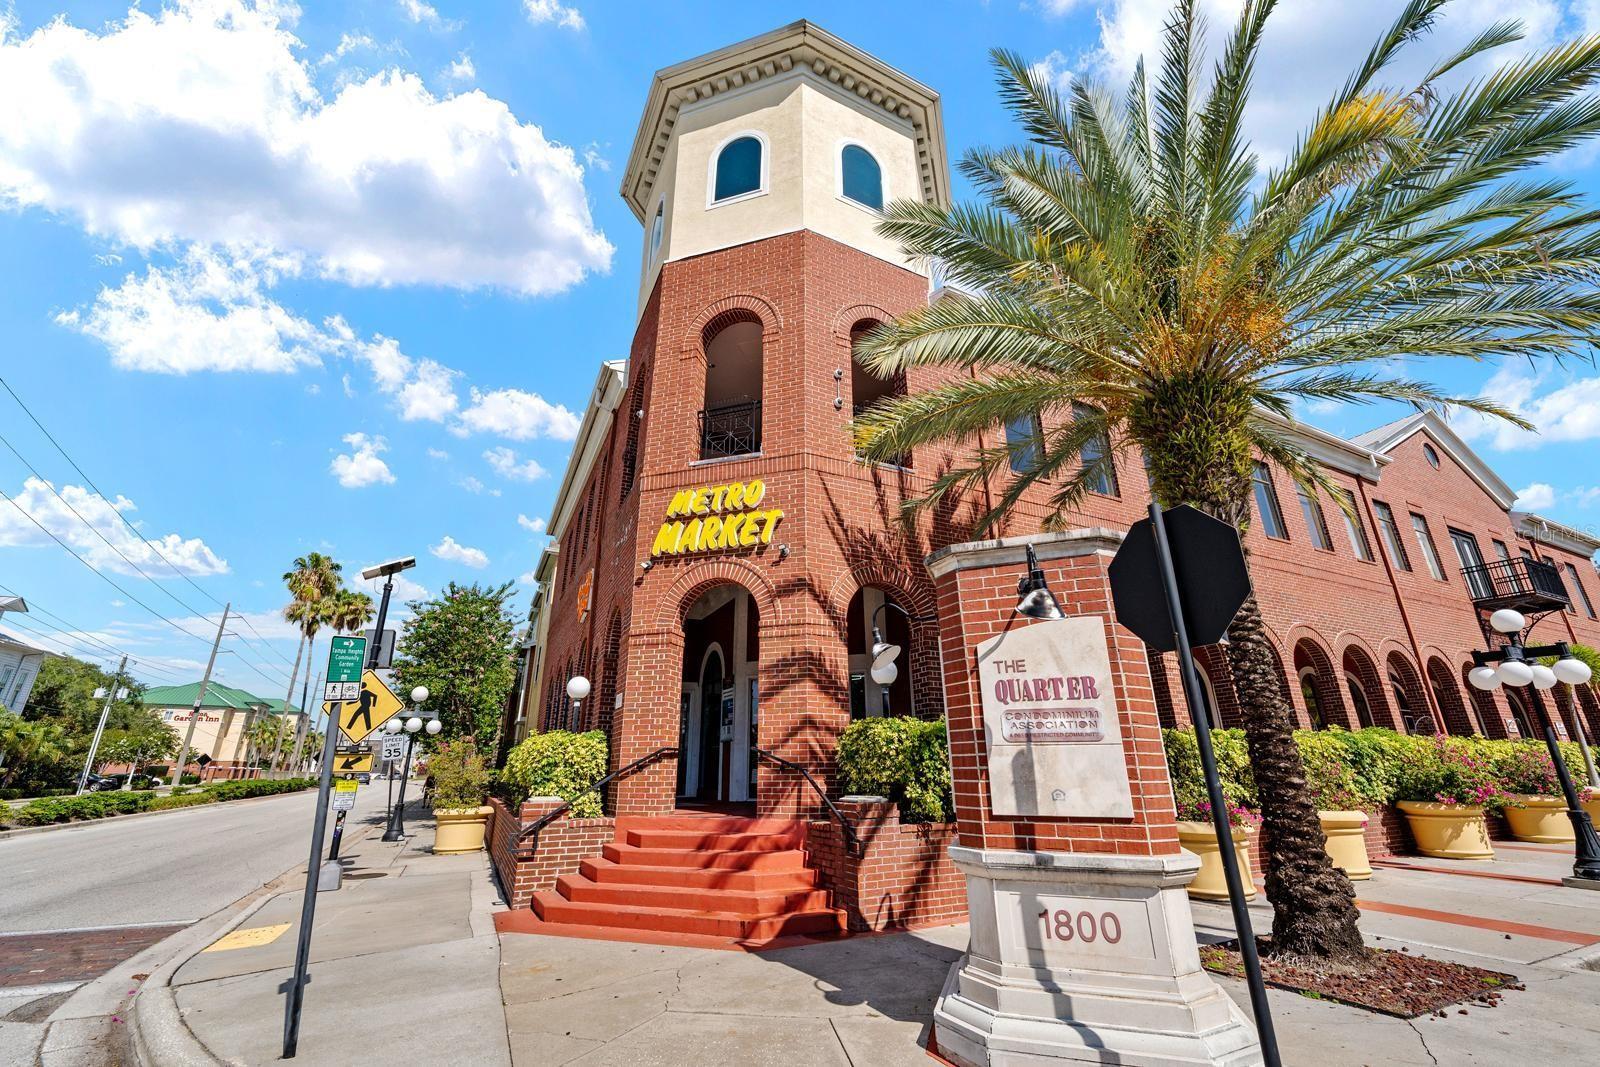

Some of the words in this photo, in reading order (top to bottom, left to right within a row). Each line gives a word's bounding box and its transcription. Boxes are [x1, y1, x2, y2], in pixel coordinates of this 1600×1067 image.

[667, 480, 765, 519] METRO
[652, 509, 785, 557] MARKET
[335, 654, 359, 662] Community
[993, 659, 1026, 673] THE
[995, 676, 1100, 705] QUARTER
[1005, 711, 1099, 720] CONDOMINIUM
[1011, 721, 1098, 729] ASSOCIATION
[384, 748, 401, 758] 35
[1039, 909, 1121, 944] 1800
